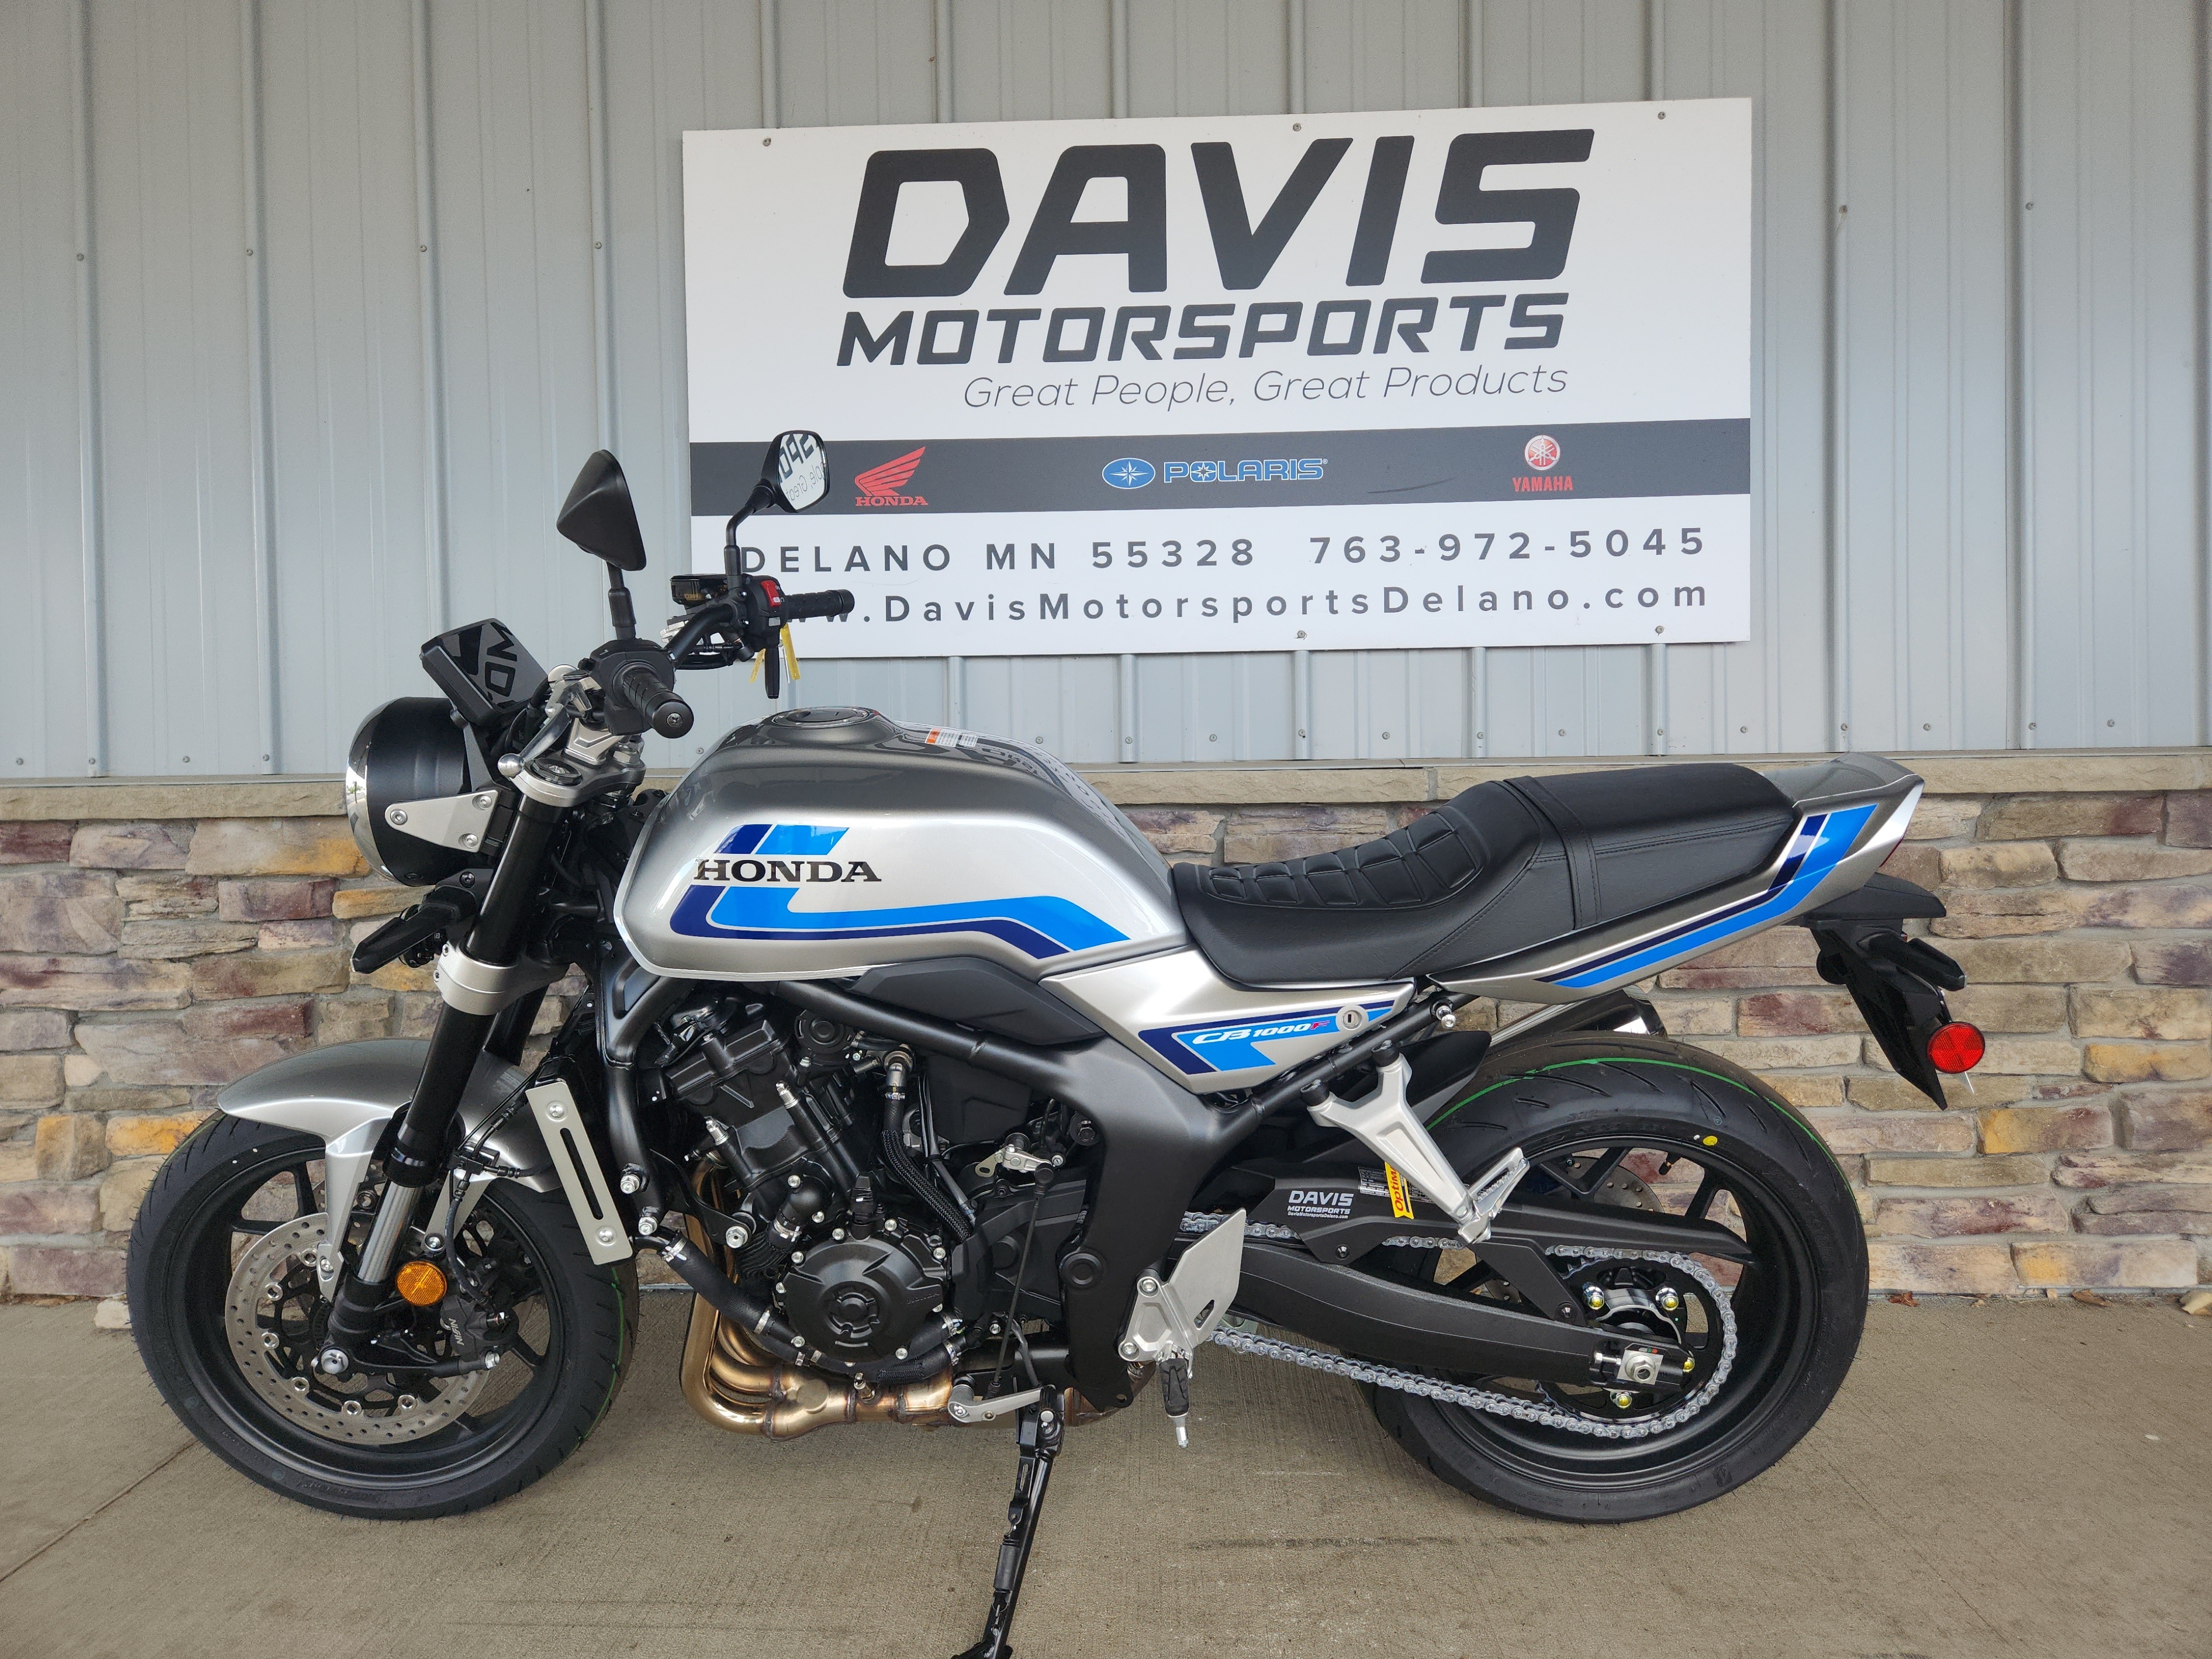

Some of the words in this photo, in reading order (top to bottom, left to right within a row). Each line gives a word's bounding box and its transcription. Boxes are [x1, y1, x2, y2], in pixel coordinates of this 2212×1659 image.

[843, 129, 1595, 298] DAVIS
[837, 292, 1569, 367] MOTORSPORTS
[964, 377, 1078, 408] Great
[1092, 373, 1235, 412] People,
[1254, 371, 1370, 401] Great
[1383, 365, 1568, 398] Products
[1164, 458, 1323, 483] POLARIS
[1512, 475, 1574, 493] YAMAHA
[855, 495, 928, 507] HONDA
[740, 545, 950, 573] DELANO
[987, 543, 1055, 570] MN
[1092, 539, 1253, 568] 55328
[1310, 527, 1703, 564] 763-972-5045
[787, 585, 1705, 623] .DavisMotorsportsDelano.com
[692, 858, 882, 883] HONDA
[1287, 1206, 1351, 1214] MOTORSPORTS
[1288, 1190, 1354, 1207] DAVIS
